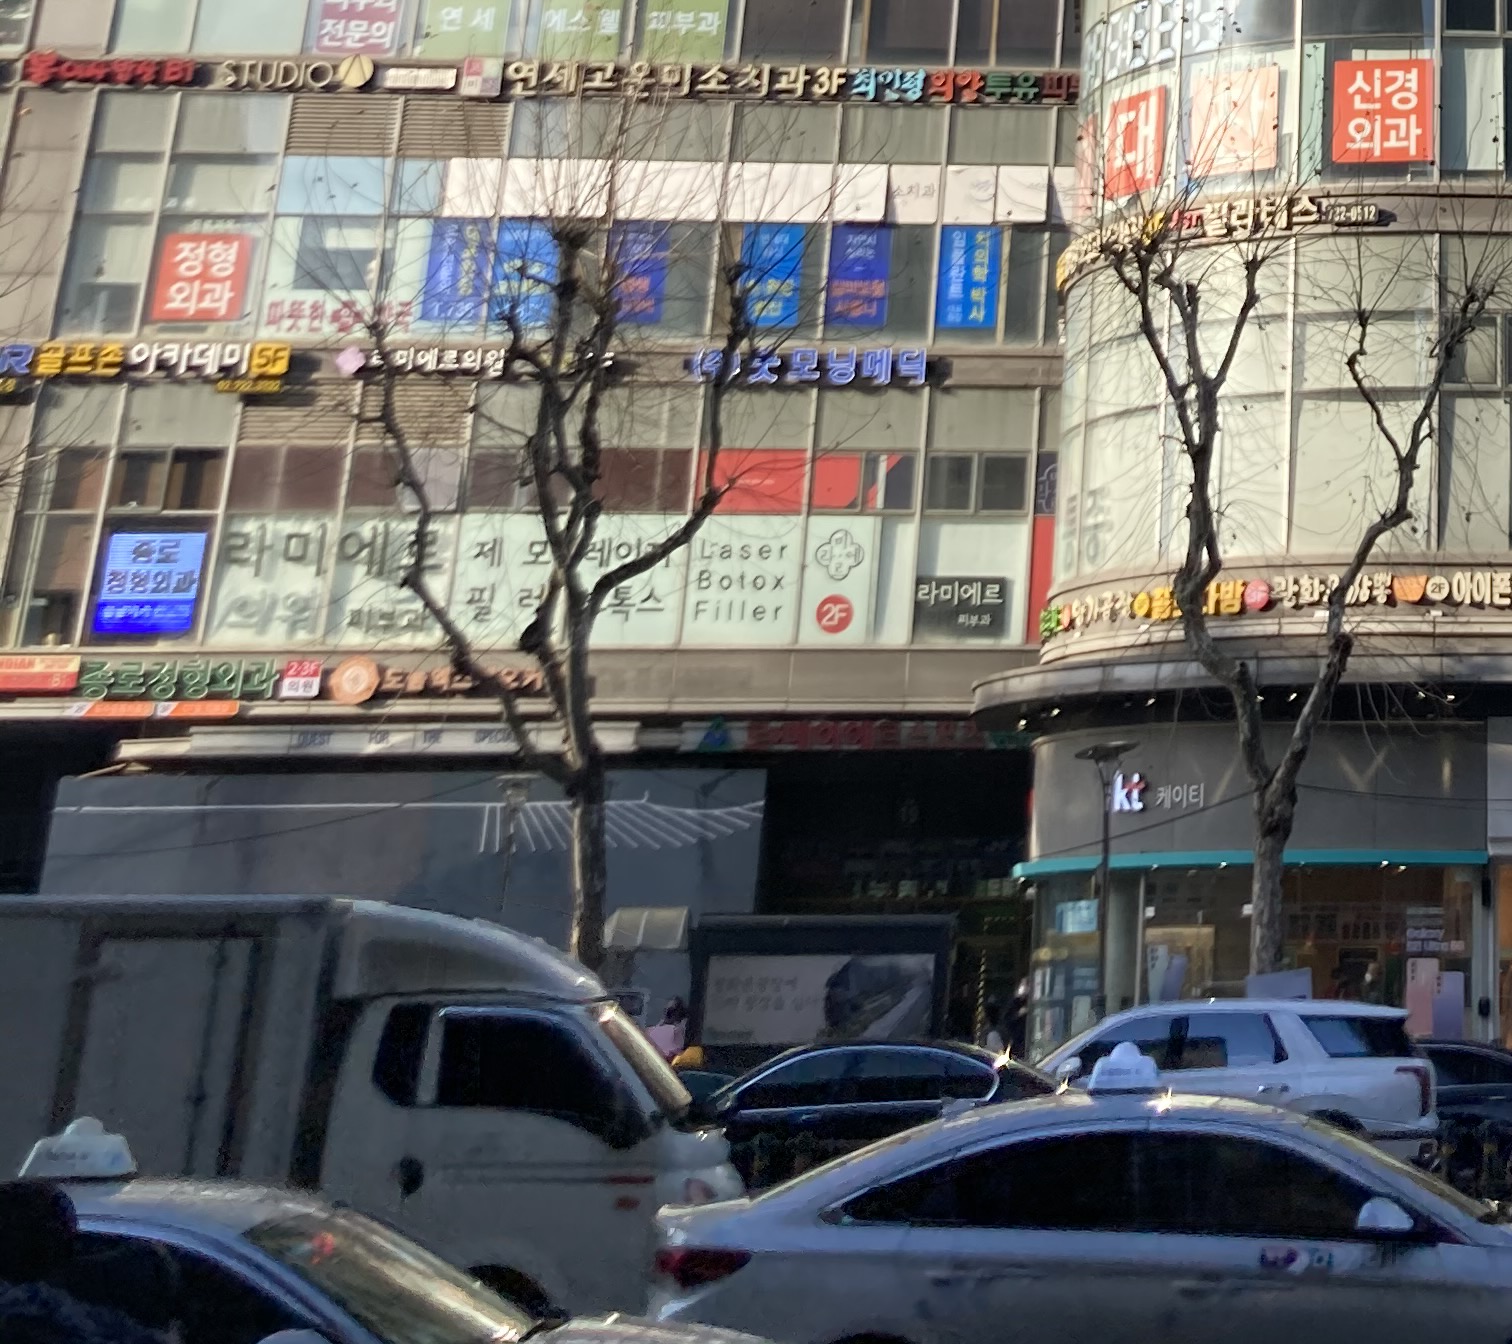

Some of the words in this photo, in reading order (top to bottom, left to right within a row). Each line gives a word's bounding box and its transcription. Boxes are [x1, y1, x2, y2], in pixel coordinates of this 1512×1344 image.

[319, 18, 395, 49] 전문의
[221, 59, 334, 89] STUDIO
[1346, 66, 1420, 111] 신경
[1345, 116, 1422, 158] 외과
[174, 240, 239, 278] 정형
[164, 279, 235, 318] 외과
[36, 342, 125, 378] 골프존
[129, 342, 250, 376] 아카데미
[700, 537, 789, 561] Laser
[697, 568, 786, 592] Botox
[916, 580, 1004, 607] 라미에르
[600, 585, 665, 622] 톡스
[691, 598, 783, 623] Filler
[820, 602, 850, 626] 2F
[79, 658, 280, 700] 종로정형외과
[1111, 770, 1148, 813] kt
[1155, 782, 1205, 808] 케이티
